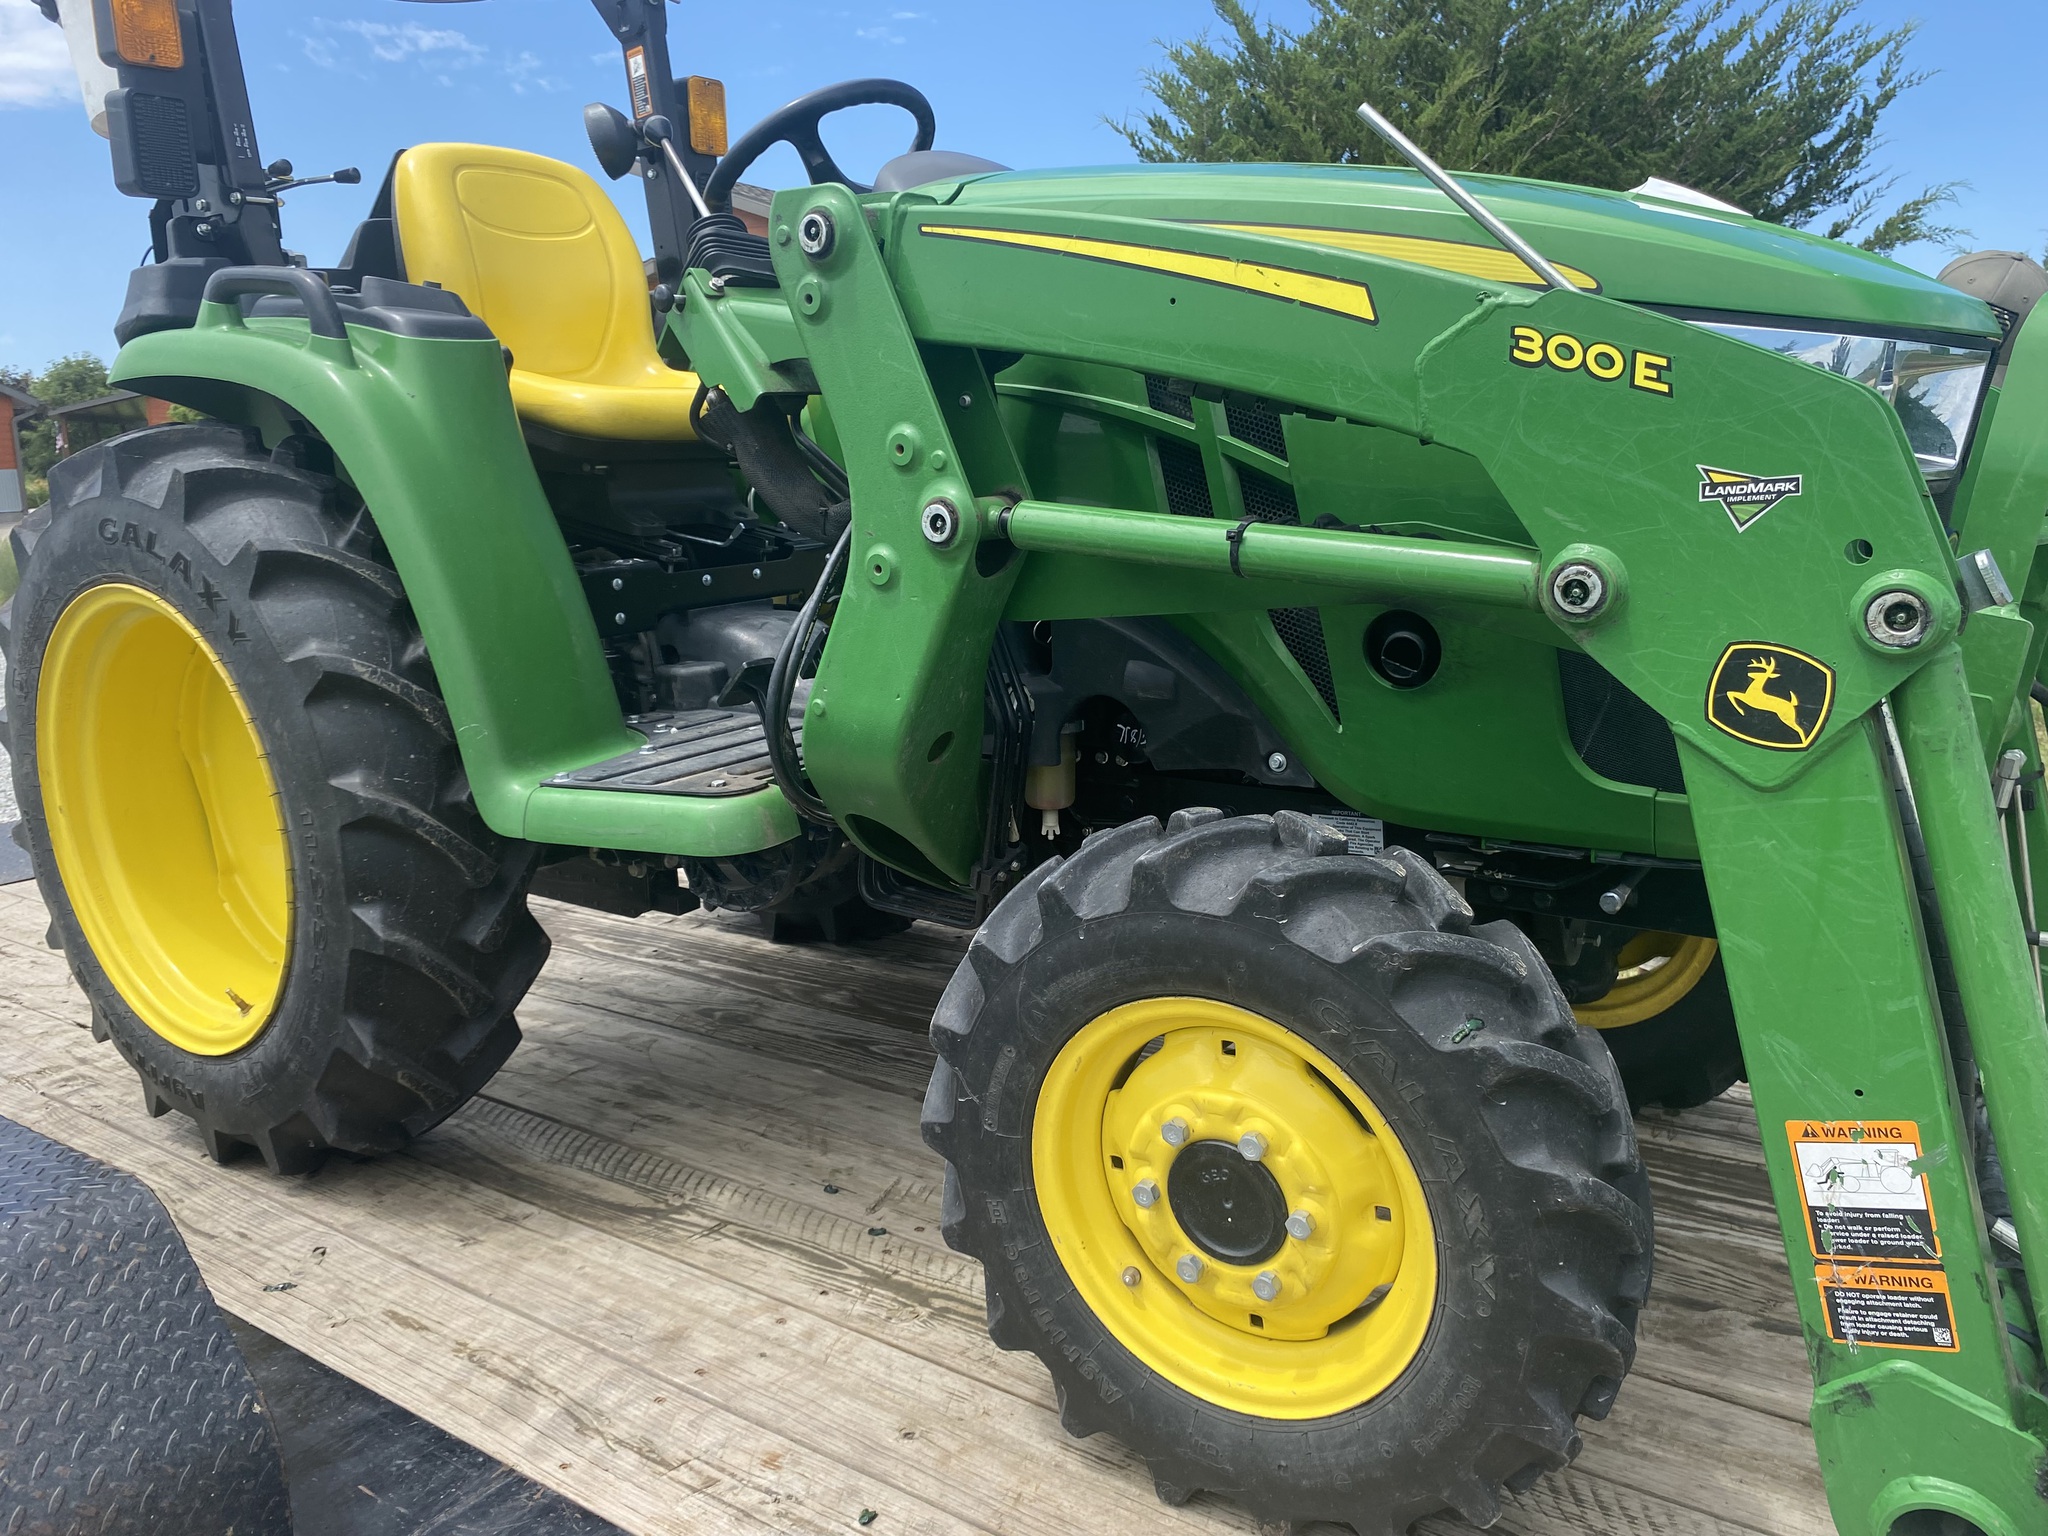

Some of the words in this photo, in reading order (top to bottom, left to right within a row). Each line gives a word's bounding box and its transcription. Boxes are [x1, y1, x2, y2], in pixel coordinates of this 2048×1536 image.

[1726, 494, 1777, 503] IMPLEMENT
[98, 517, 252, 647] GALAXY
[1311, 997, 1497, 1302] GALAXY
[1855, 1275, 1934, 1289] WARNING
[1003, 1243, 1125, 1406] AgriTrac
[1902, 1319, 1935, 1327] detaching
